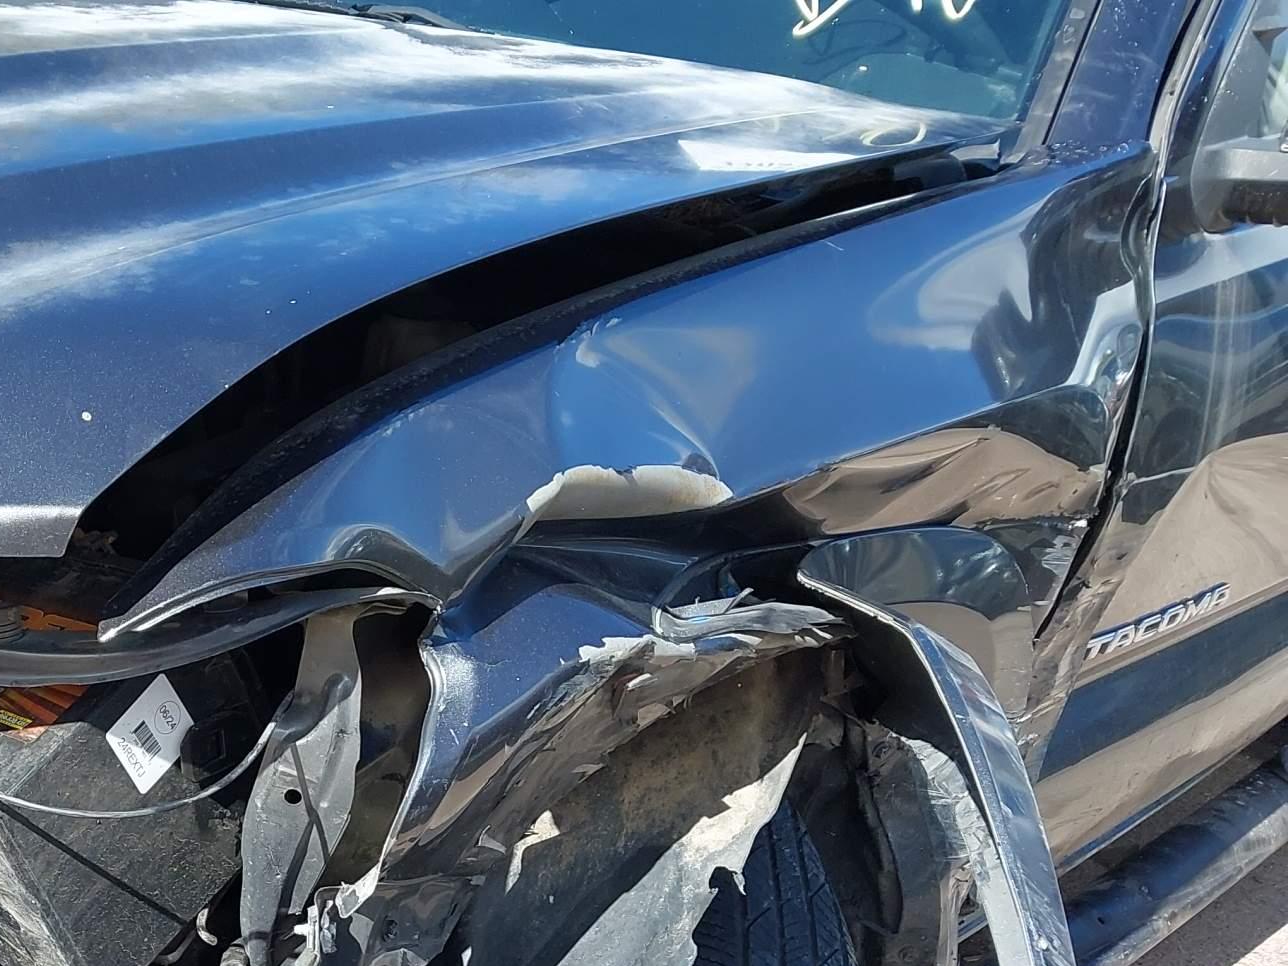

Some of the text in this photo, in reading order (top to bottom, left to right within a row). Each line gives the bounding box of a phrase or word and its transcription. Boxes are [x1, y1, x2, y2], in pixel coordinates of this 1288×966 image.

[1086, 582, 1232, 660] TACOMA
[159, 704, 177, 731] 06/24
[116, 736, 146, 778] 24REXTJ
